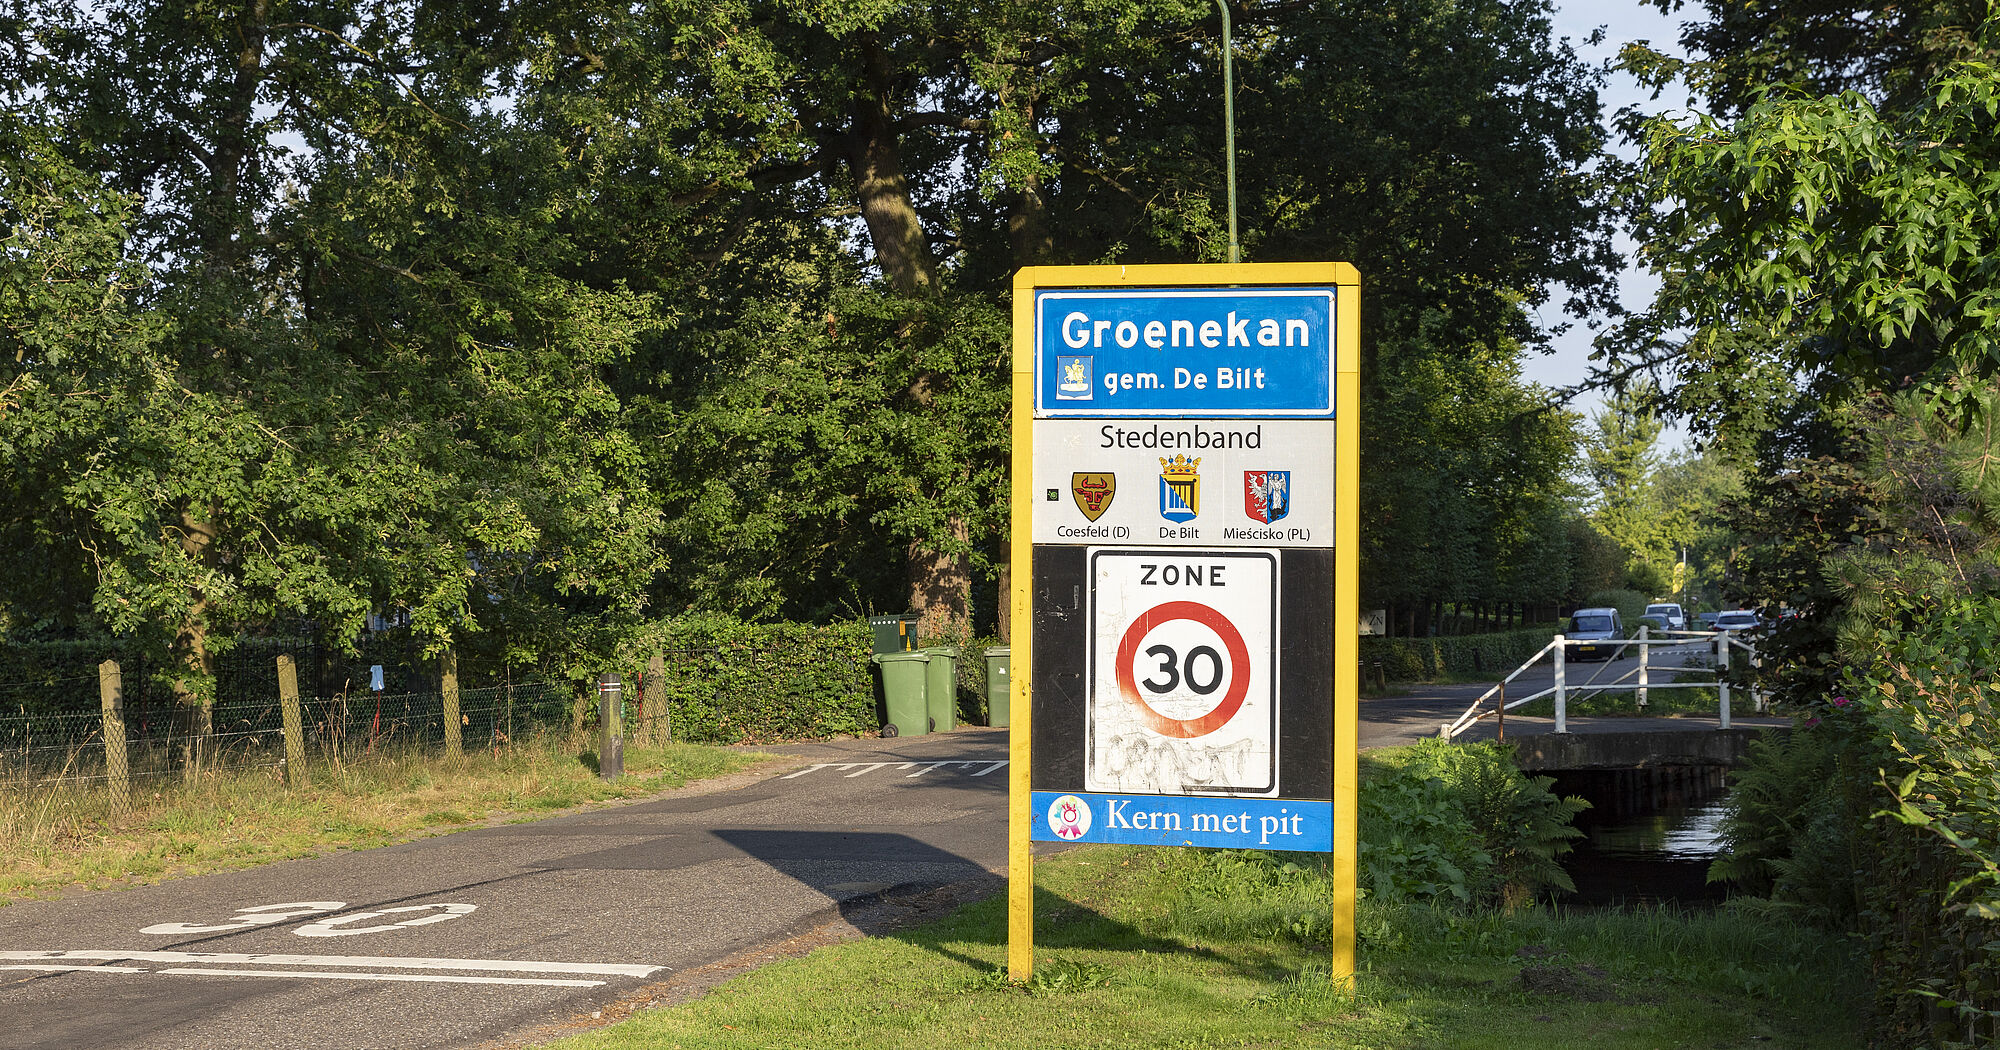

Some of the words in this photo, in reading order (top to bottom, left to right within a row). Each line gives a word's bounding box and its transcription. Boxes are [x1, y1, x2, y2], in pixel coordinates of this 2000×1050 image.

[1062, 311, 1308, 349] Groenekan
[1104, 373, 1165, 396] gem.
[1174, 368, 1208, 390] De
[1217, 368, 1265, 390] Bilt
[1100, 425, 1261, 449] Stedenband
[1057, 526, 1109, 538] Coesfeld
[1112, 526, 1130, 540] (D)
[1159, 527, 1177, 539] De
[1179, 526, 1200, 539] Bilt
[1224, 526, 1285, 540] Mieścisko
[1287, 527, 1311, 542] (PL)
[1140, 564, 1226, 587] ZONE
[1142, 644, 1224, 695] 30
[1106, 799, 1183, 831] Kern
[1191, 811, 1251, 834] met
[1259, 808, 1304, 845] pit
[139, 901, 478, 937] 30
